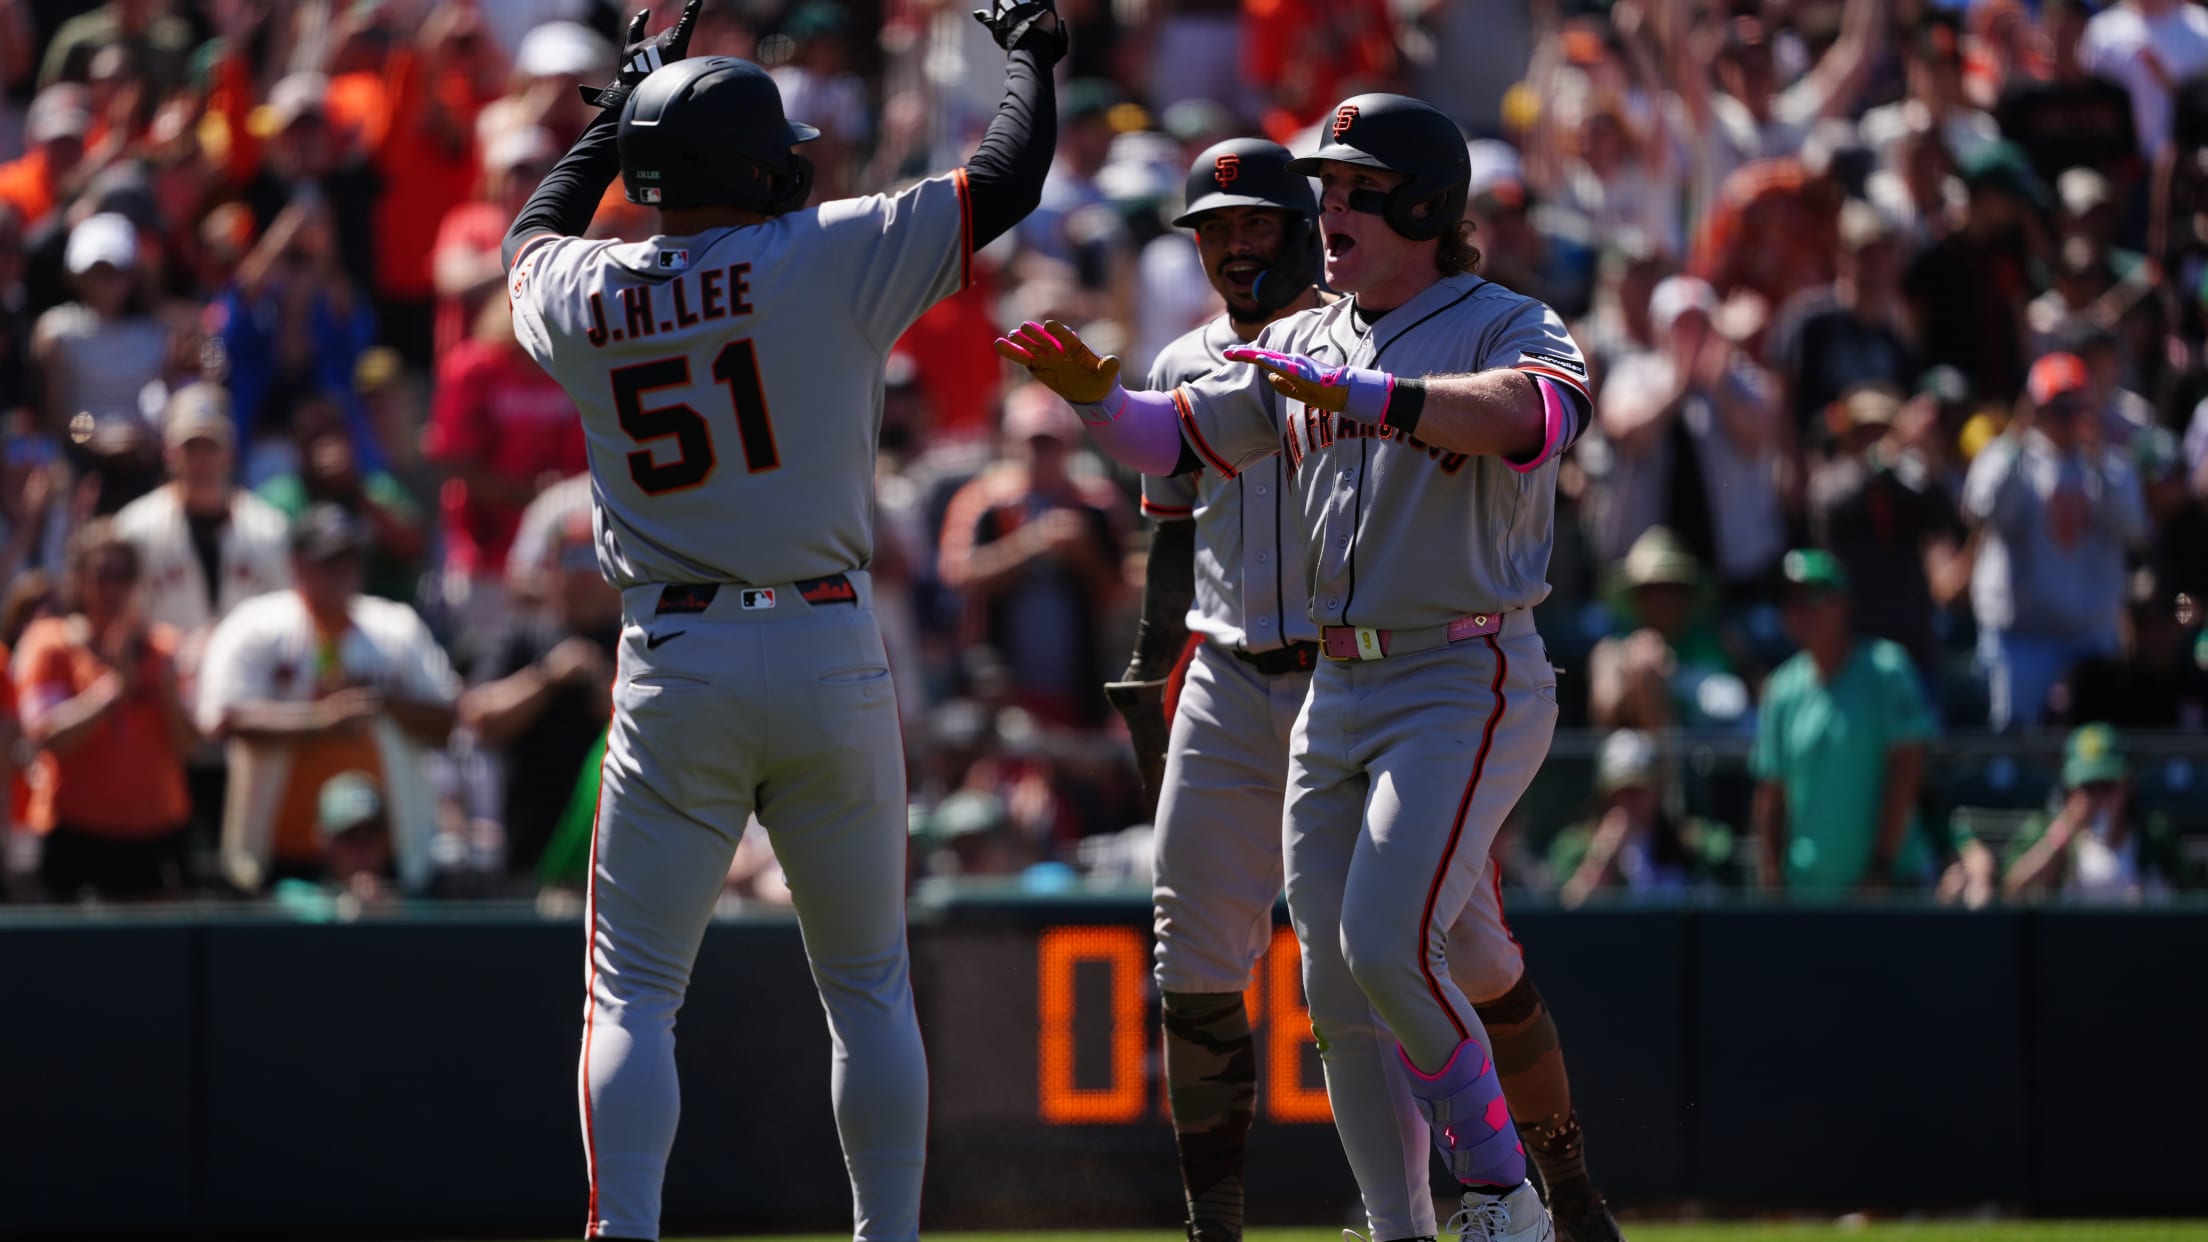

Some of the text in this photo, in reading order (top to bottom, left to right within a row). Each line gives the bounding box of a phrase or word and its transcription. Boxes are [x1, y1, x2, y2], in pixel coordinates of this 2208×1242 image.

[587, 262, 753, 347] J.H.LEE
[609, 337, 782, 497] 51
[1298, 650, 1308, 665] 2
[1362, 631, 1373, 650] 9
